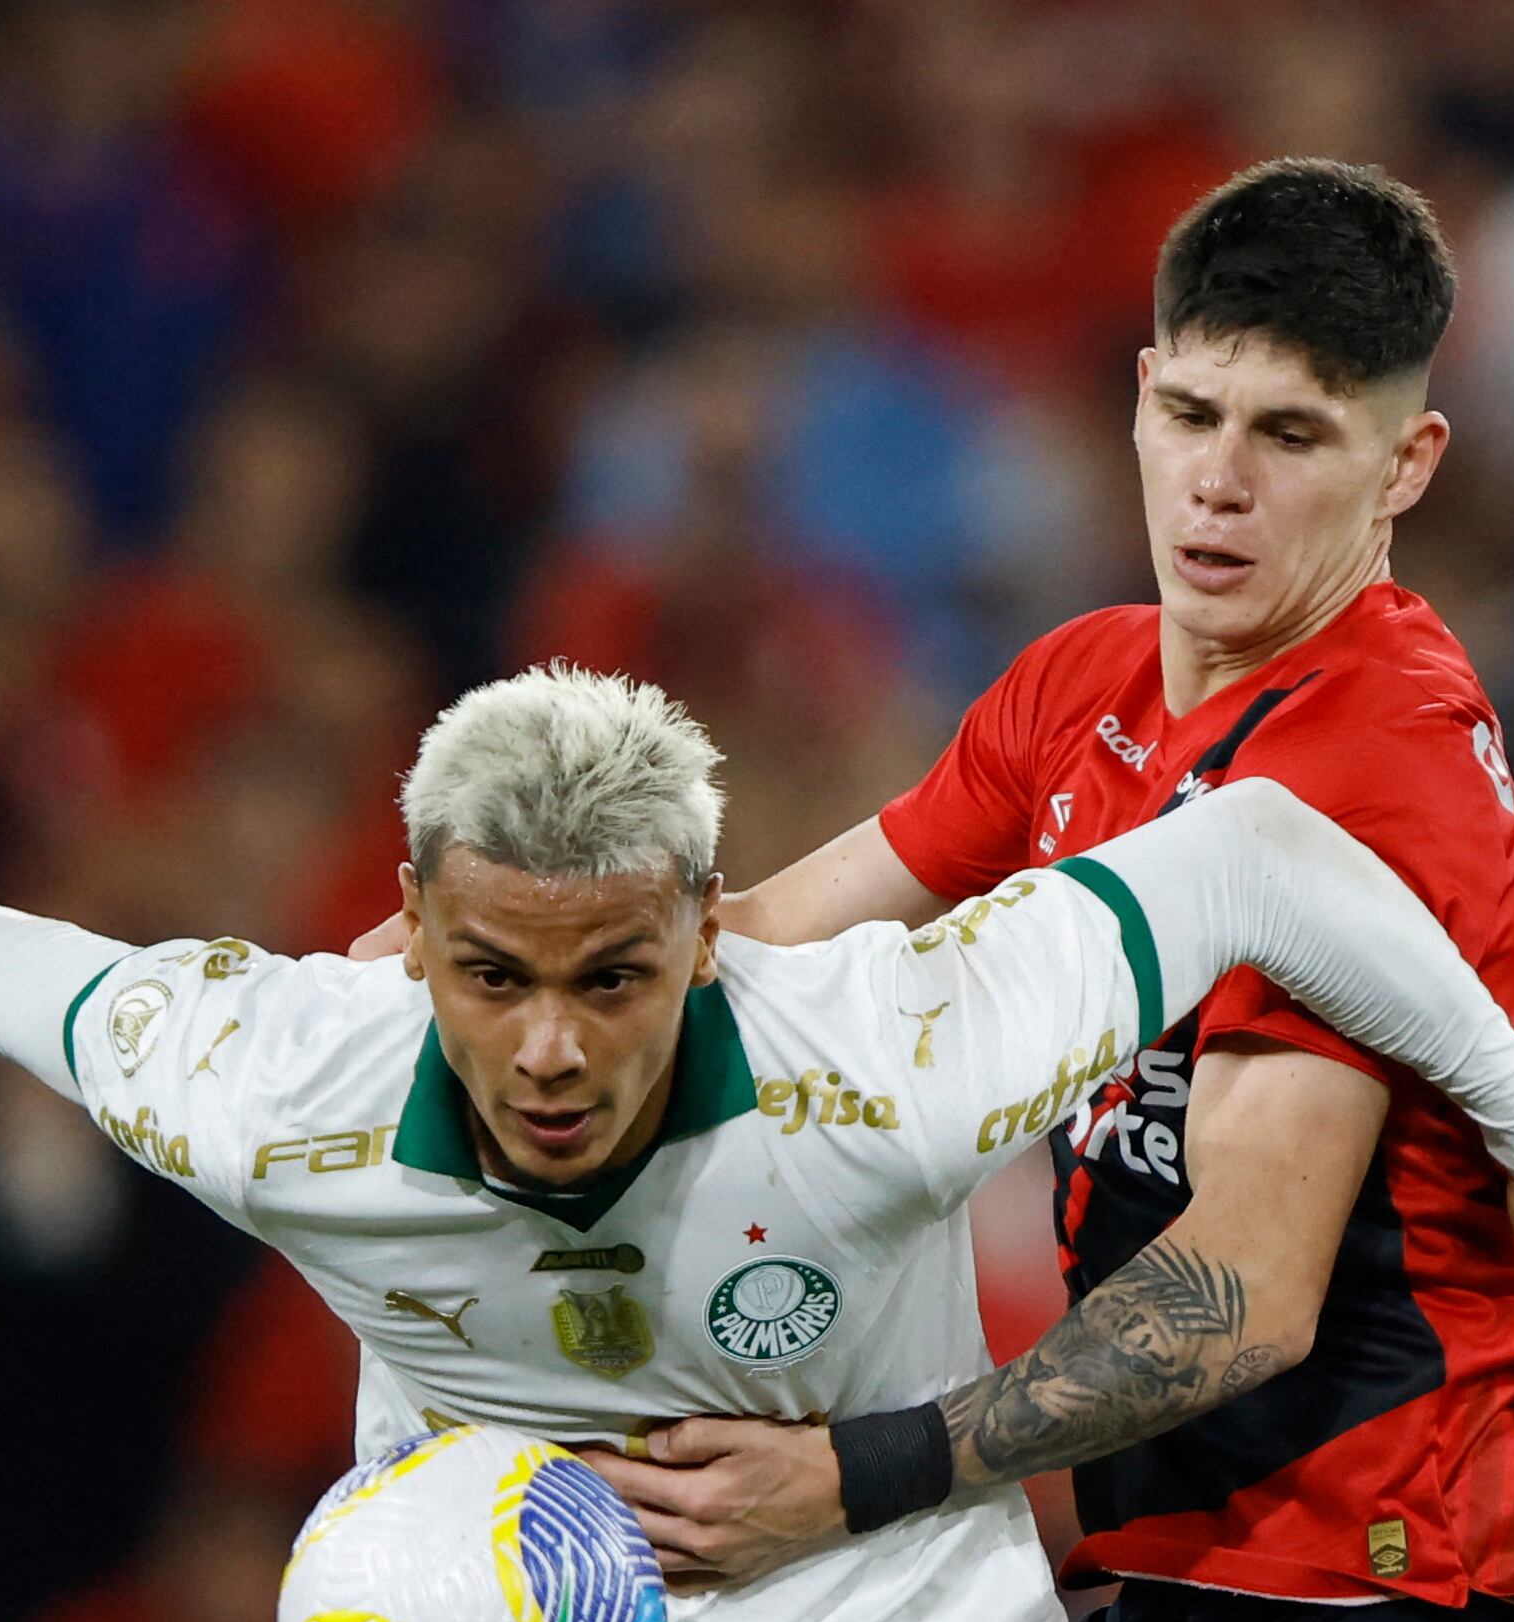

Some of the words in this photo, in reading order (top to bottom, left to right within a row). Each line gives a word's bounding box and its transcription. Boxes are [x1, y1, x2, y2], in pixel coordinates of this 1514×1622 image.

[755, 1067, 902, 1135] efisa
[977, 1027, 1119, 1154] crefia
[712, 1291, 835, 1358] PALMEIRAS
